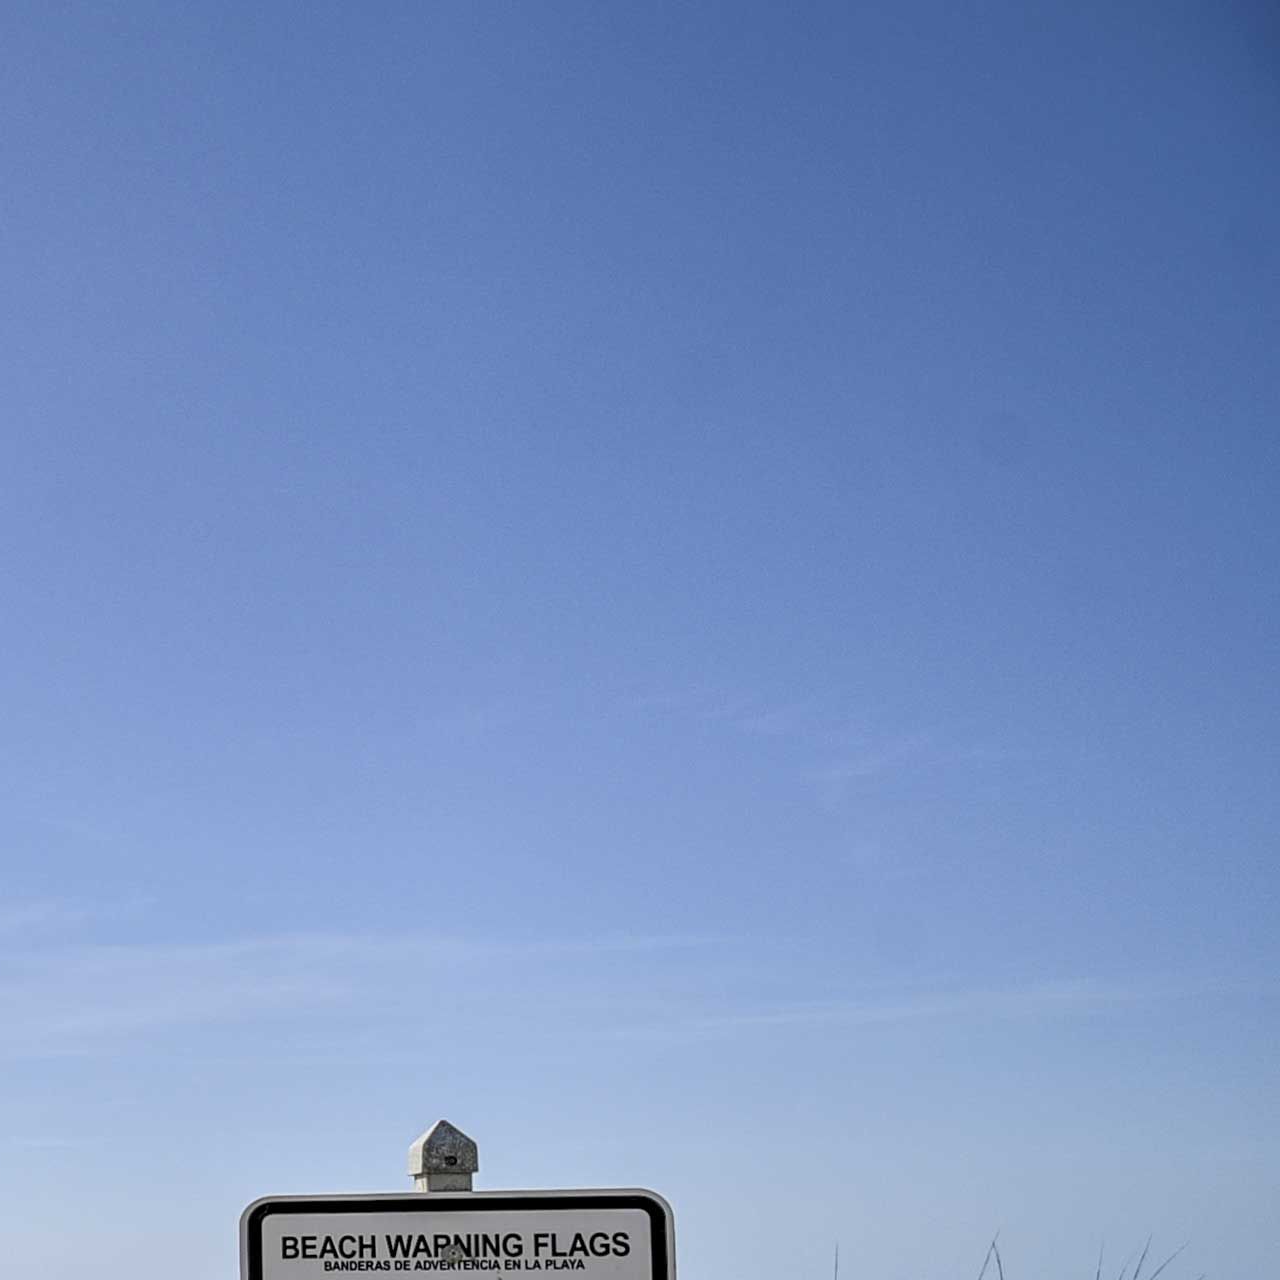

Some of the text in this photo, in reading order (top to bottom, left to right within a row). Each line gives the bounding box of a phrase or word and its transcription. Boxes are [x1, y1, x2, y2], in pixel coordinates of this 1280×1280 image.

[281, 1232, 630, 1259] BEACH WARNING FLAGS
[324, 1259, 586, 1271] BANDERAS DE ADVERTENCIA EN LA PLAYA
